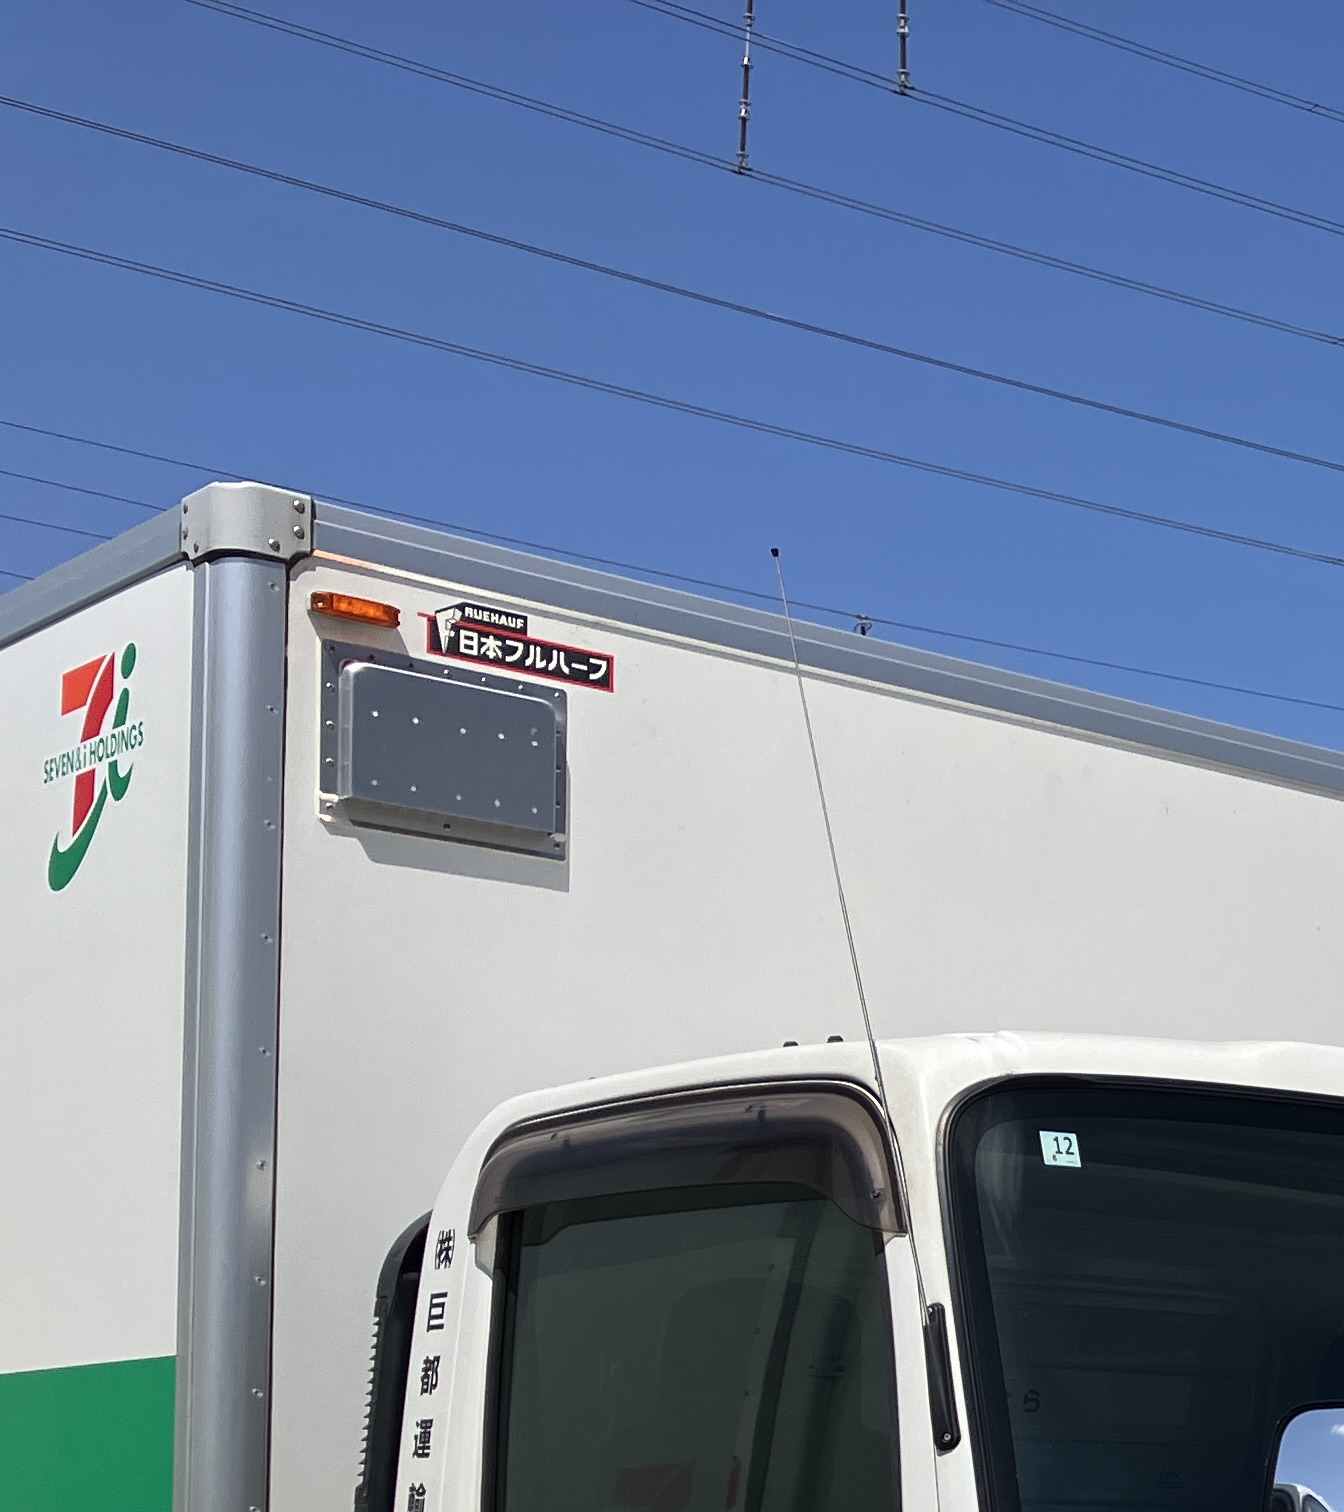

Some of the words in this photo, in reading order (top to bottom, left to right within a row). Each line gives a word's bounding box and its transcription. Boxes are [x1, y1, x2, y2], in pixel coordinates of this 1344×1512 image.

[459, 629, 608, 681] 日本フルハーフ
[89, 721, 144, 764] HOLDINGS
[1053, 1136, 1075, 1155] 12
